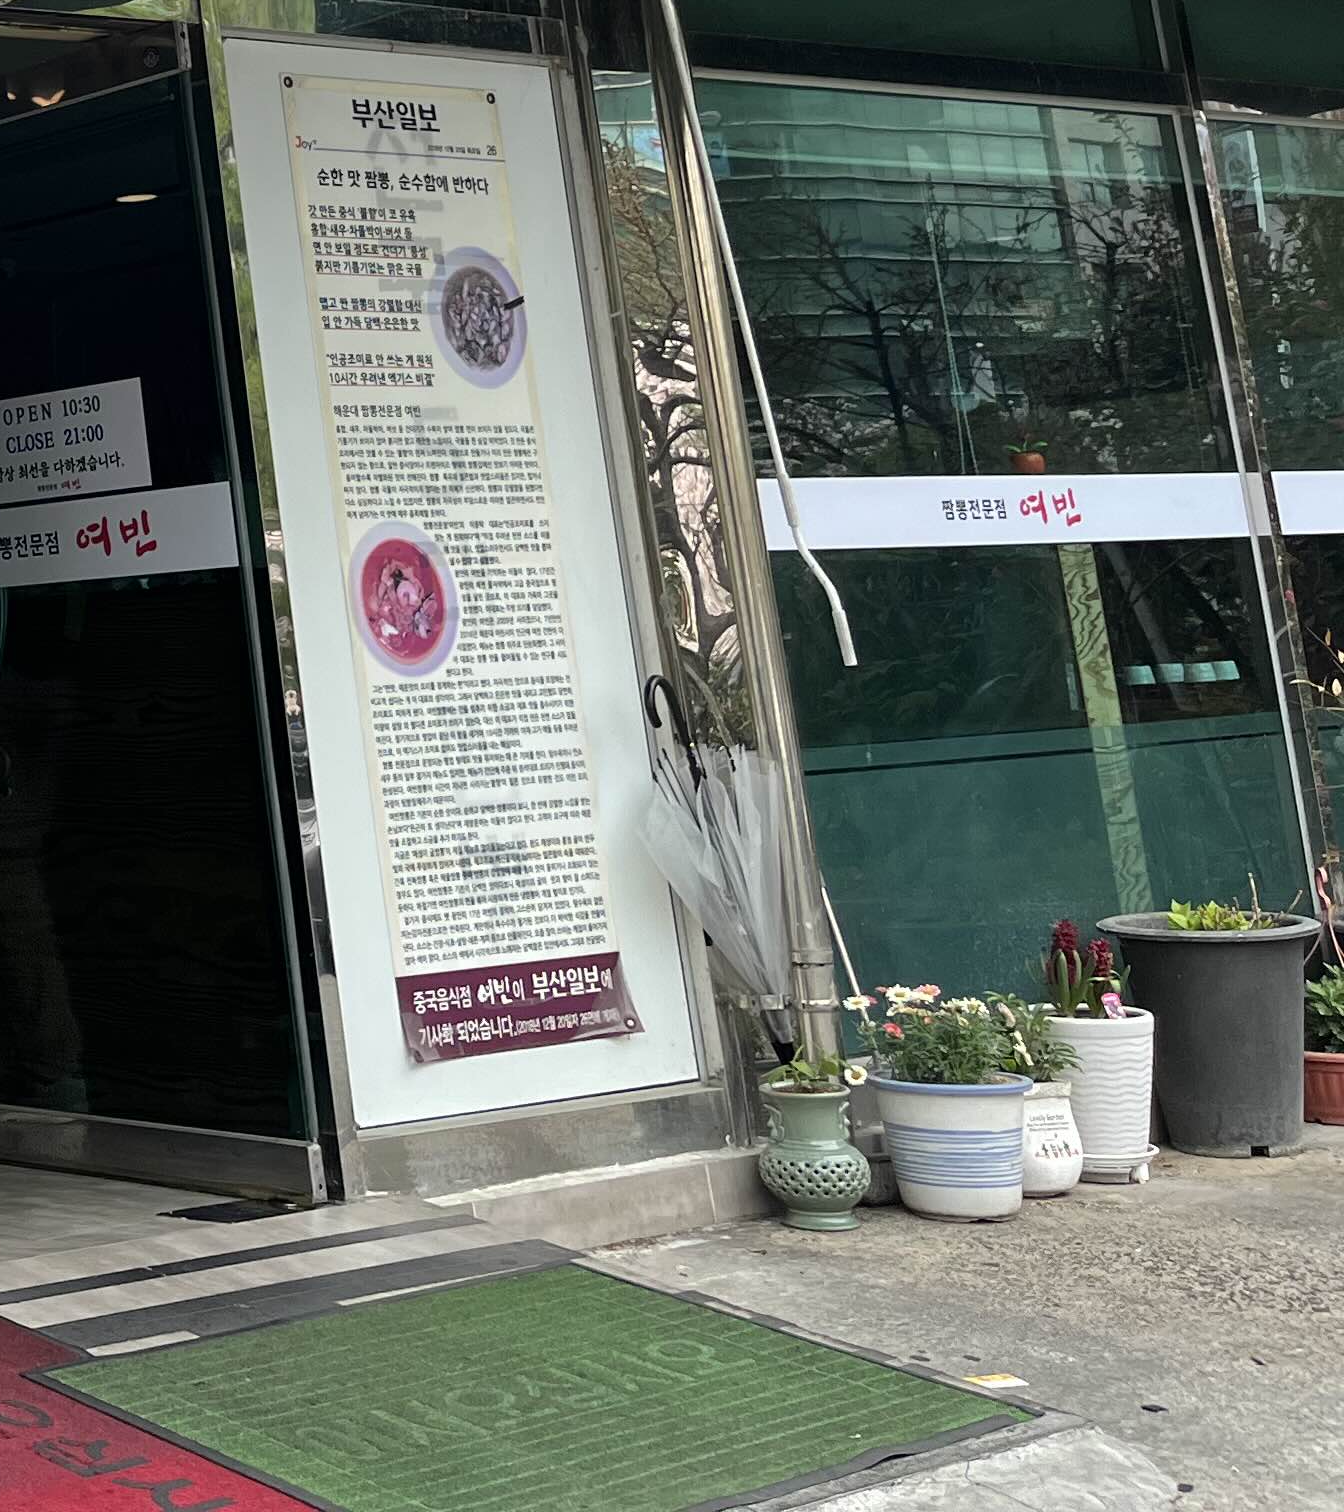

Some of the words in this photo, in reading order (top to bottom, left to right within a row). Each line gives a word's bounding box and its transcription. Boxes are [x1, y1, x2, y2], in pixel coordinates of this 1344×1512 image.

[352, 98, 440, 132] 부산일보
[317, 168, 344, 187] 순한
[347, 169, 360, 188] 맛
[364, 172, 394, 191] 짬뽕,
[398, 173, 448, 193] 순수함에
[452, 176, 490, 195] 반하다
[2, 401, 52, 426] OPEN
[61, 394, 101, 417] 10:30
[6, 431, 55, 454] CLOSE
[64, 423, 104, 446] 21:00
[18, 461, 50, 480] 최선을
[53, 451, 126, 475] 다하겠습니다.
[941, 498, 1007, 521] 짬뽕전문점
[1019, 488, 1082, 527] 여빈
[75, 509, 157, 557] 여빈
[413, 985, 473, 1014] 중국음식점
[477, 975, 525, 1005] 여빈이
[532, 965, 613, 1001] 부산일보에
[419, 1022, 455, 1048] 기사화
[456, 1015, 517, 1045] 되었습니다.
